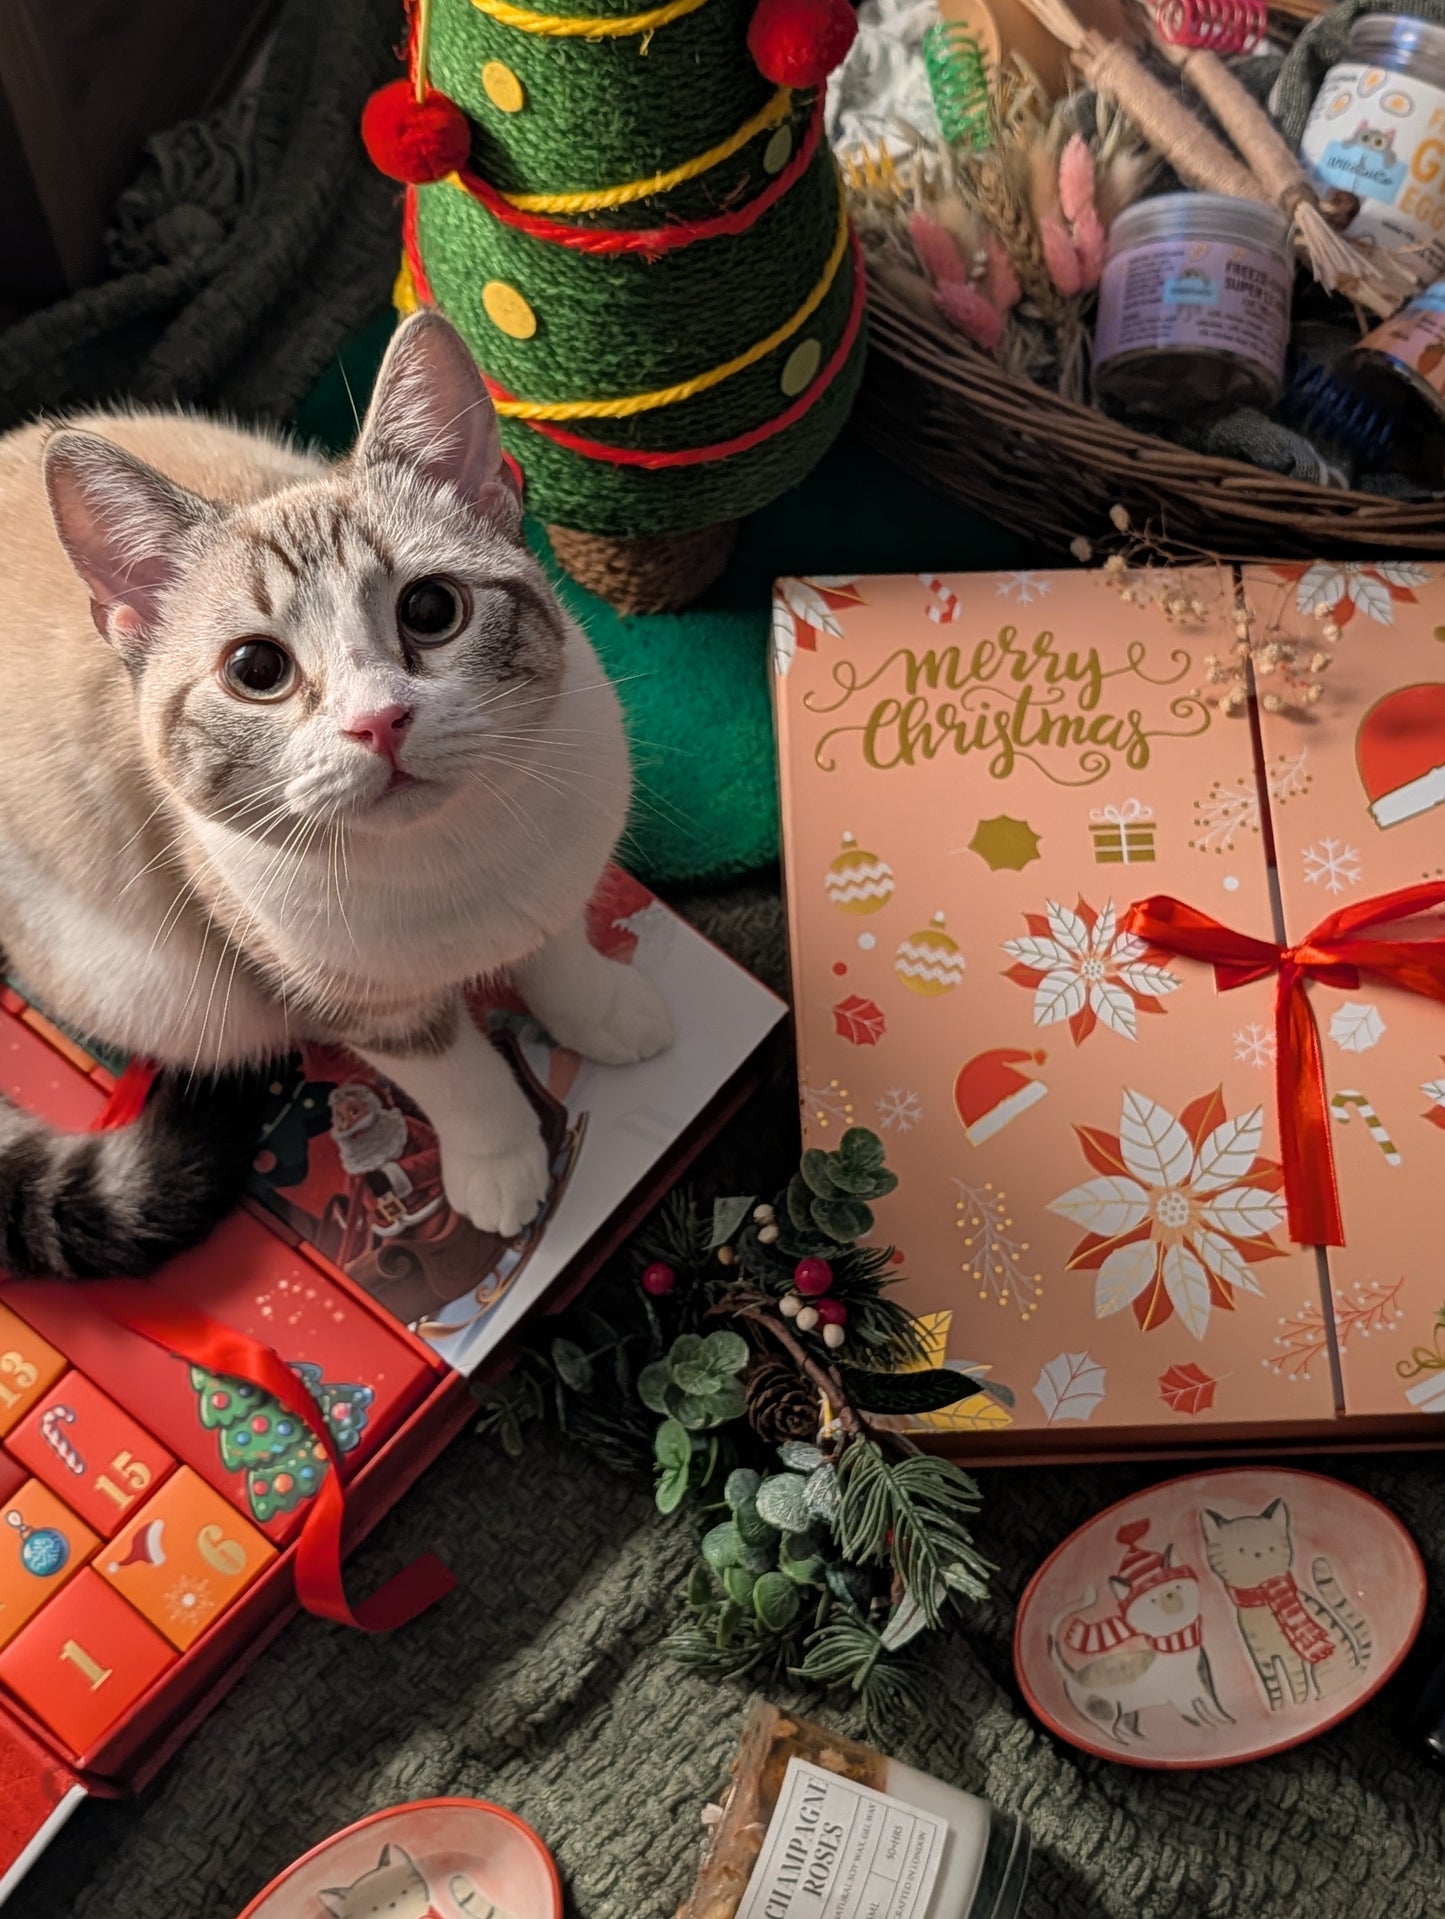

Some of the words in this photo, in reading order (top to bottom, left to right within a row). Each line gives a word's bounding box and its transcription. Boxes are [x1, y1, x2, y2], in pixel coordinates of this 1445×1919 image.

[803, 624, 1191, 711] merry
[815, 685, 1211, 787] Christmas
[94, 1451, 152, 1509] 15
[197, 1524, 247, 1576] 6
[59, 1639, 113, 1691] 1
[764, 1777, 830, 1919] CHAMPAGNE
[802, 1822, 844, 1897] ROSES
[847, 1864, 859, 1881] SOY
[866, 1802, 876, 1821] WAX
[911, 1832, 926, 1869] LONDON
[907, 1869, 916, 1882] IN
